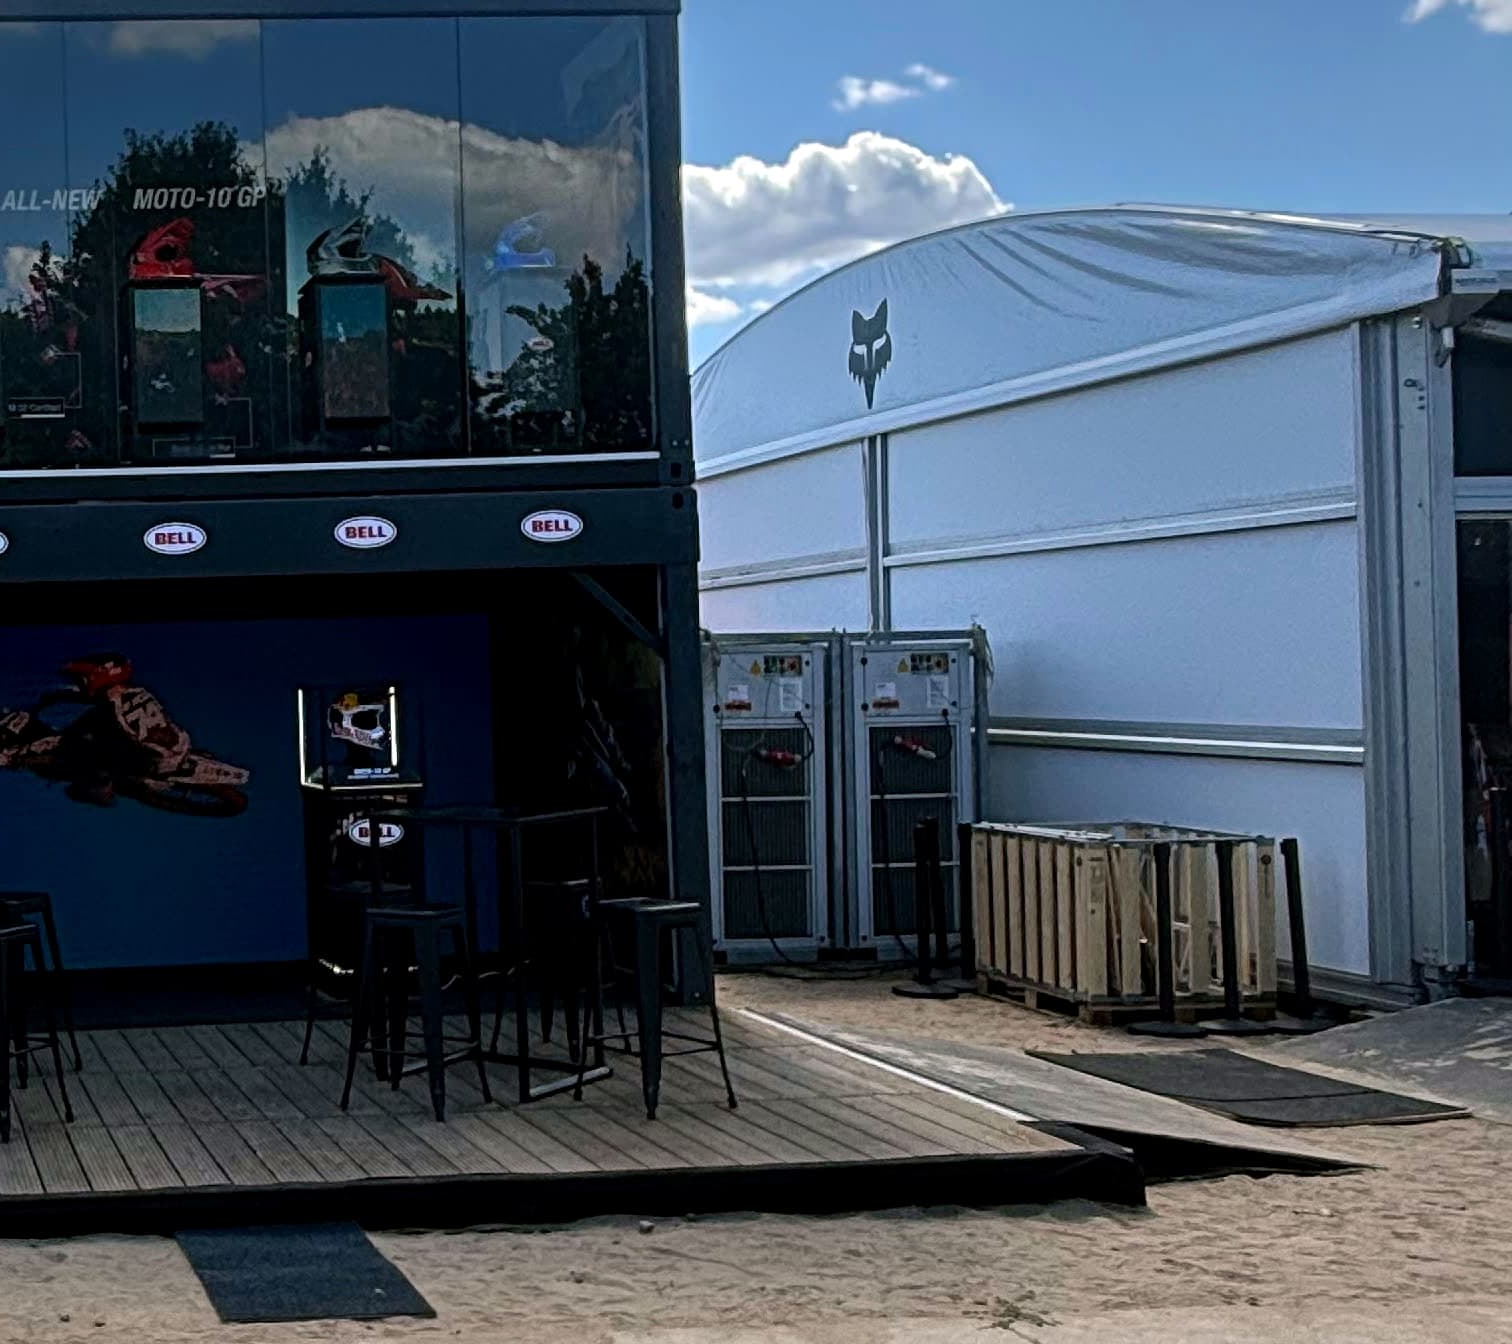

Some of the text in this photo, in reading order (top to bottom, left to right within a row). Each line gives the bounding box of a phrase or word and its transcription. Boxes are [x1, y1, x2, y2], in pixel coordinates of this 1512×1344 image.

[0, 188, 103, 212] ALL-NEW
[132, 187, 232, 211] MOTO-10
[236, 185, 267, 209] GP
[344, 524, 387, 540] BELL
[531, 518, 573, 534] BELL
[154, 530, 197, 546] BELL
